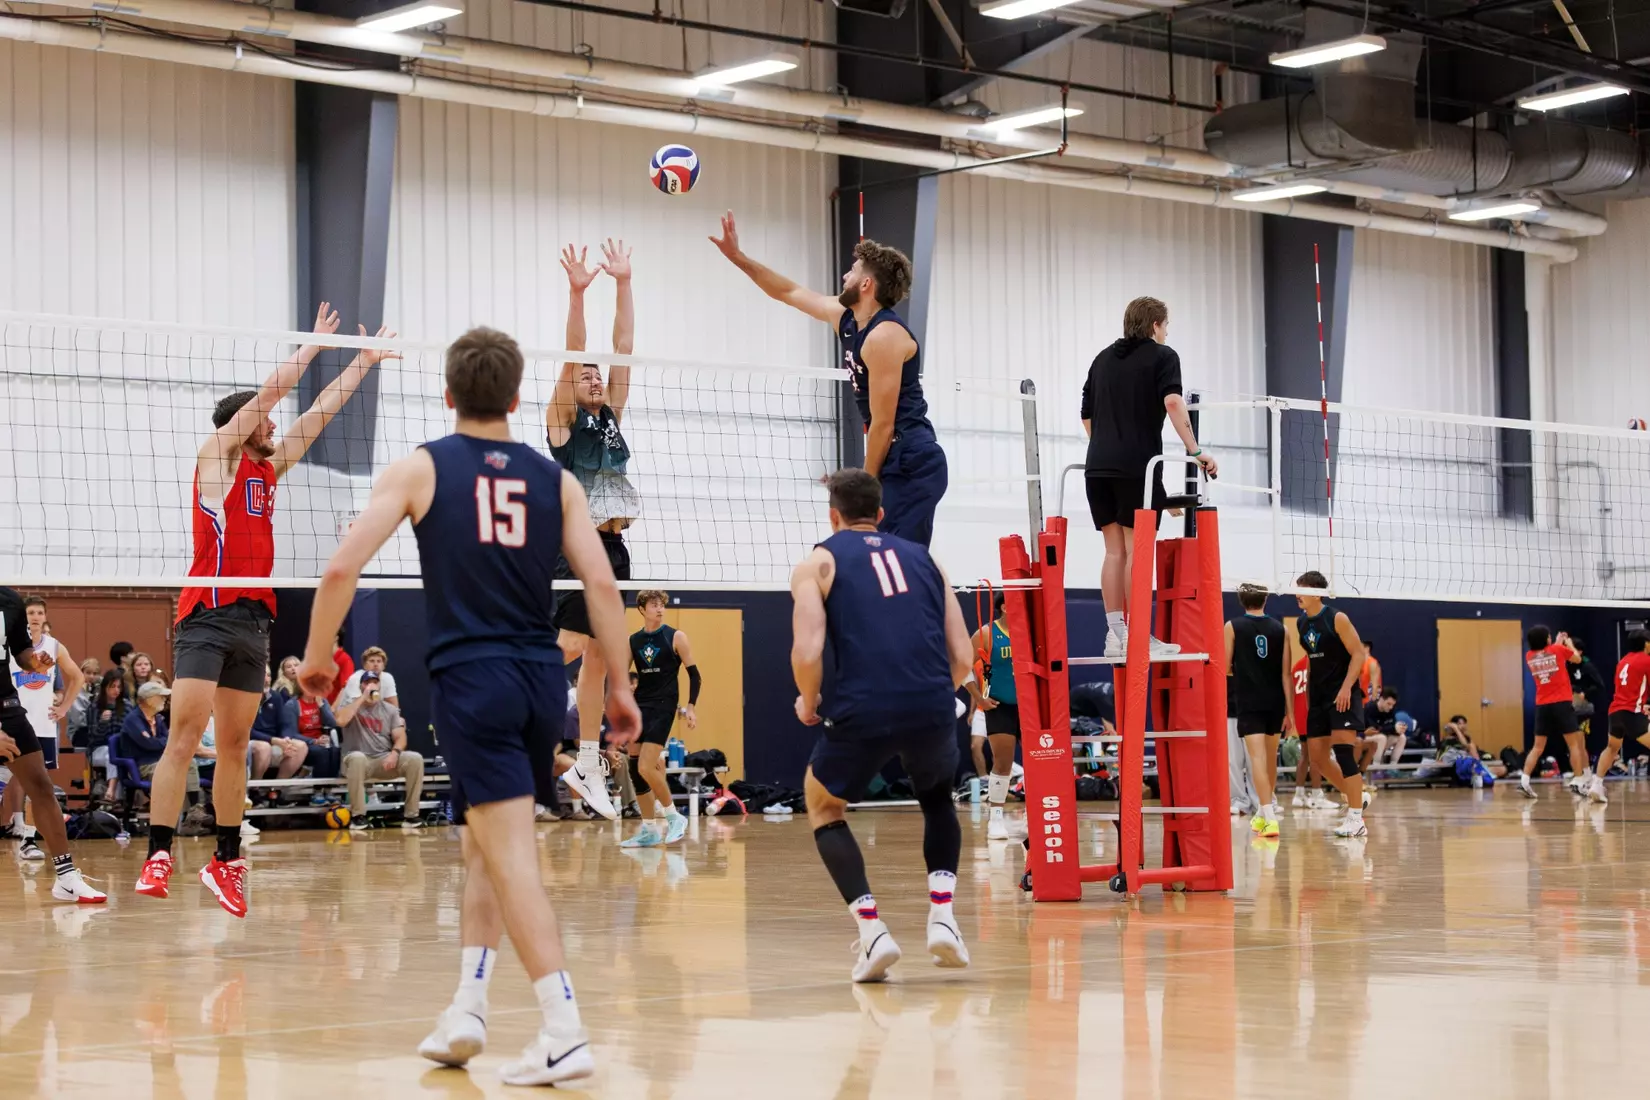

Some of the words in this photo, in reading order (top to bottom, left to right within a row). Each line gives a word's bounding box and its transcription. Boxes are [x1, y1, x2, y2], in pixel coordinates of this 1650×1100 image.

[474, 474, 527, 549] 15
[869, 547, 909, 598] 11
[1255, 634, 1268, 658] 9
[1619, 663, 1629, 685] 4
[1042, 795, 1063, 863] senoh
